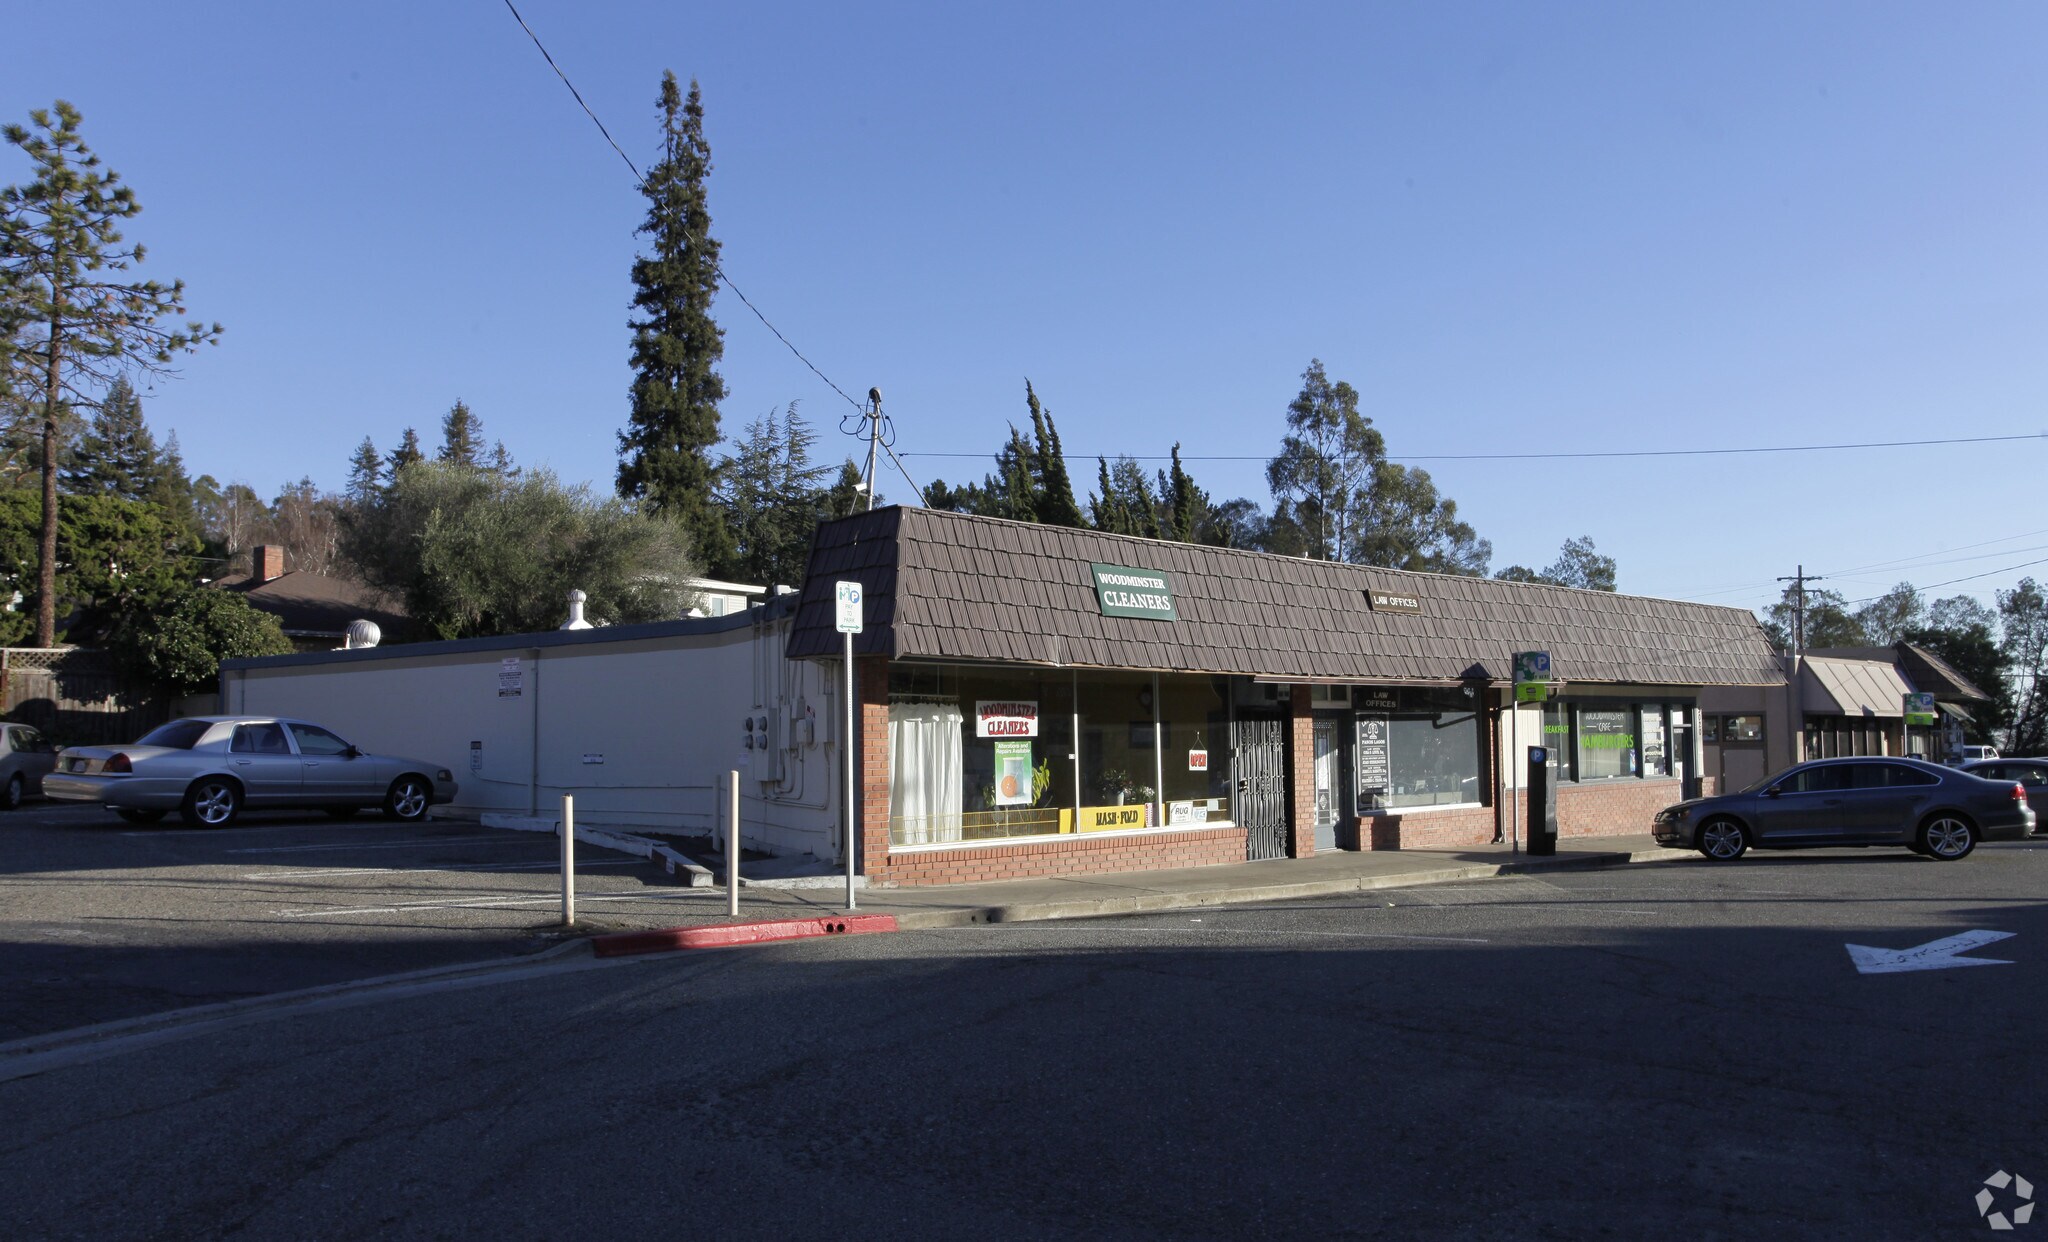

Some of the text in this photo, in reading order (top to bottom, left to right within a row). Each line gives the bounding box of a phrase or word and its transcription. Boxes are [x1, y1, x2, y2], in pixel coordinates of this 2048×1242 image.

[1098, 573, 1166, 590] WOODMINSTER
[1103, 591, 1171, 611] CLEANERS
[1373, 595, 1418, 608] LAW OFFICES
[1374, 691, 1388, 699] LAW
[1365, 700, 1396, 708] OFFICES
[979, 702, 1037, 721] WOODMINSTER
[988, 721, 1030, 735] CLEANERS
[1190, 753, 1206, 767] OPEN
[1096, 811, 1117, 826] WASH
[1120, 809, 1139, 825] FOLD
[1175, 806, 1189, 815] RUG
